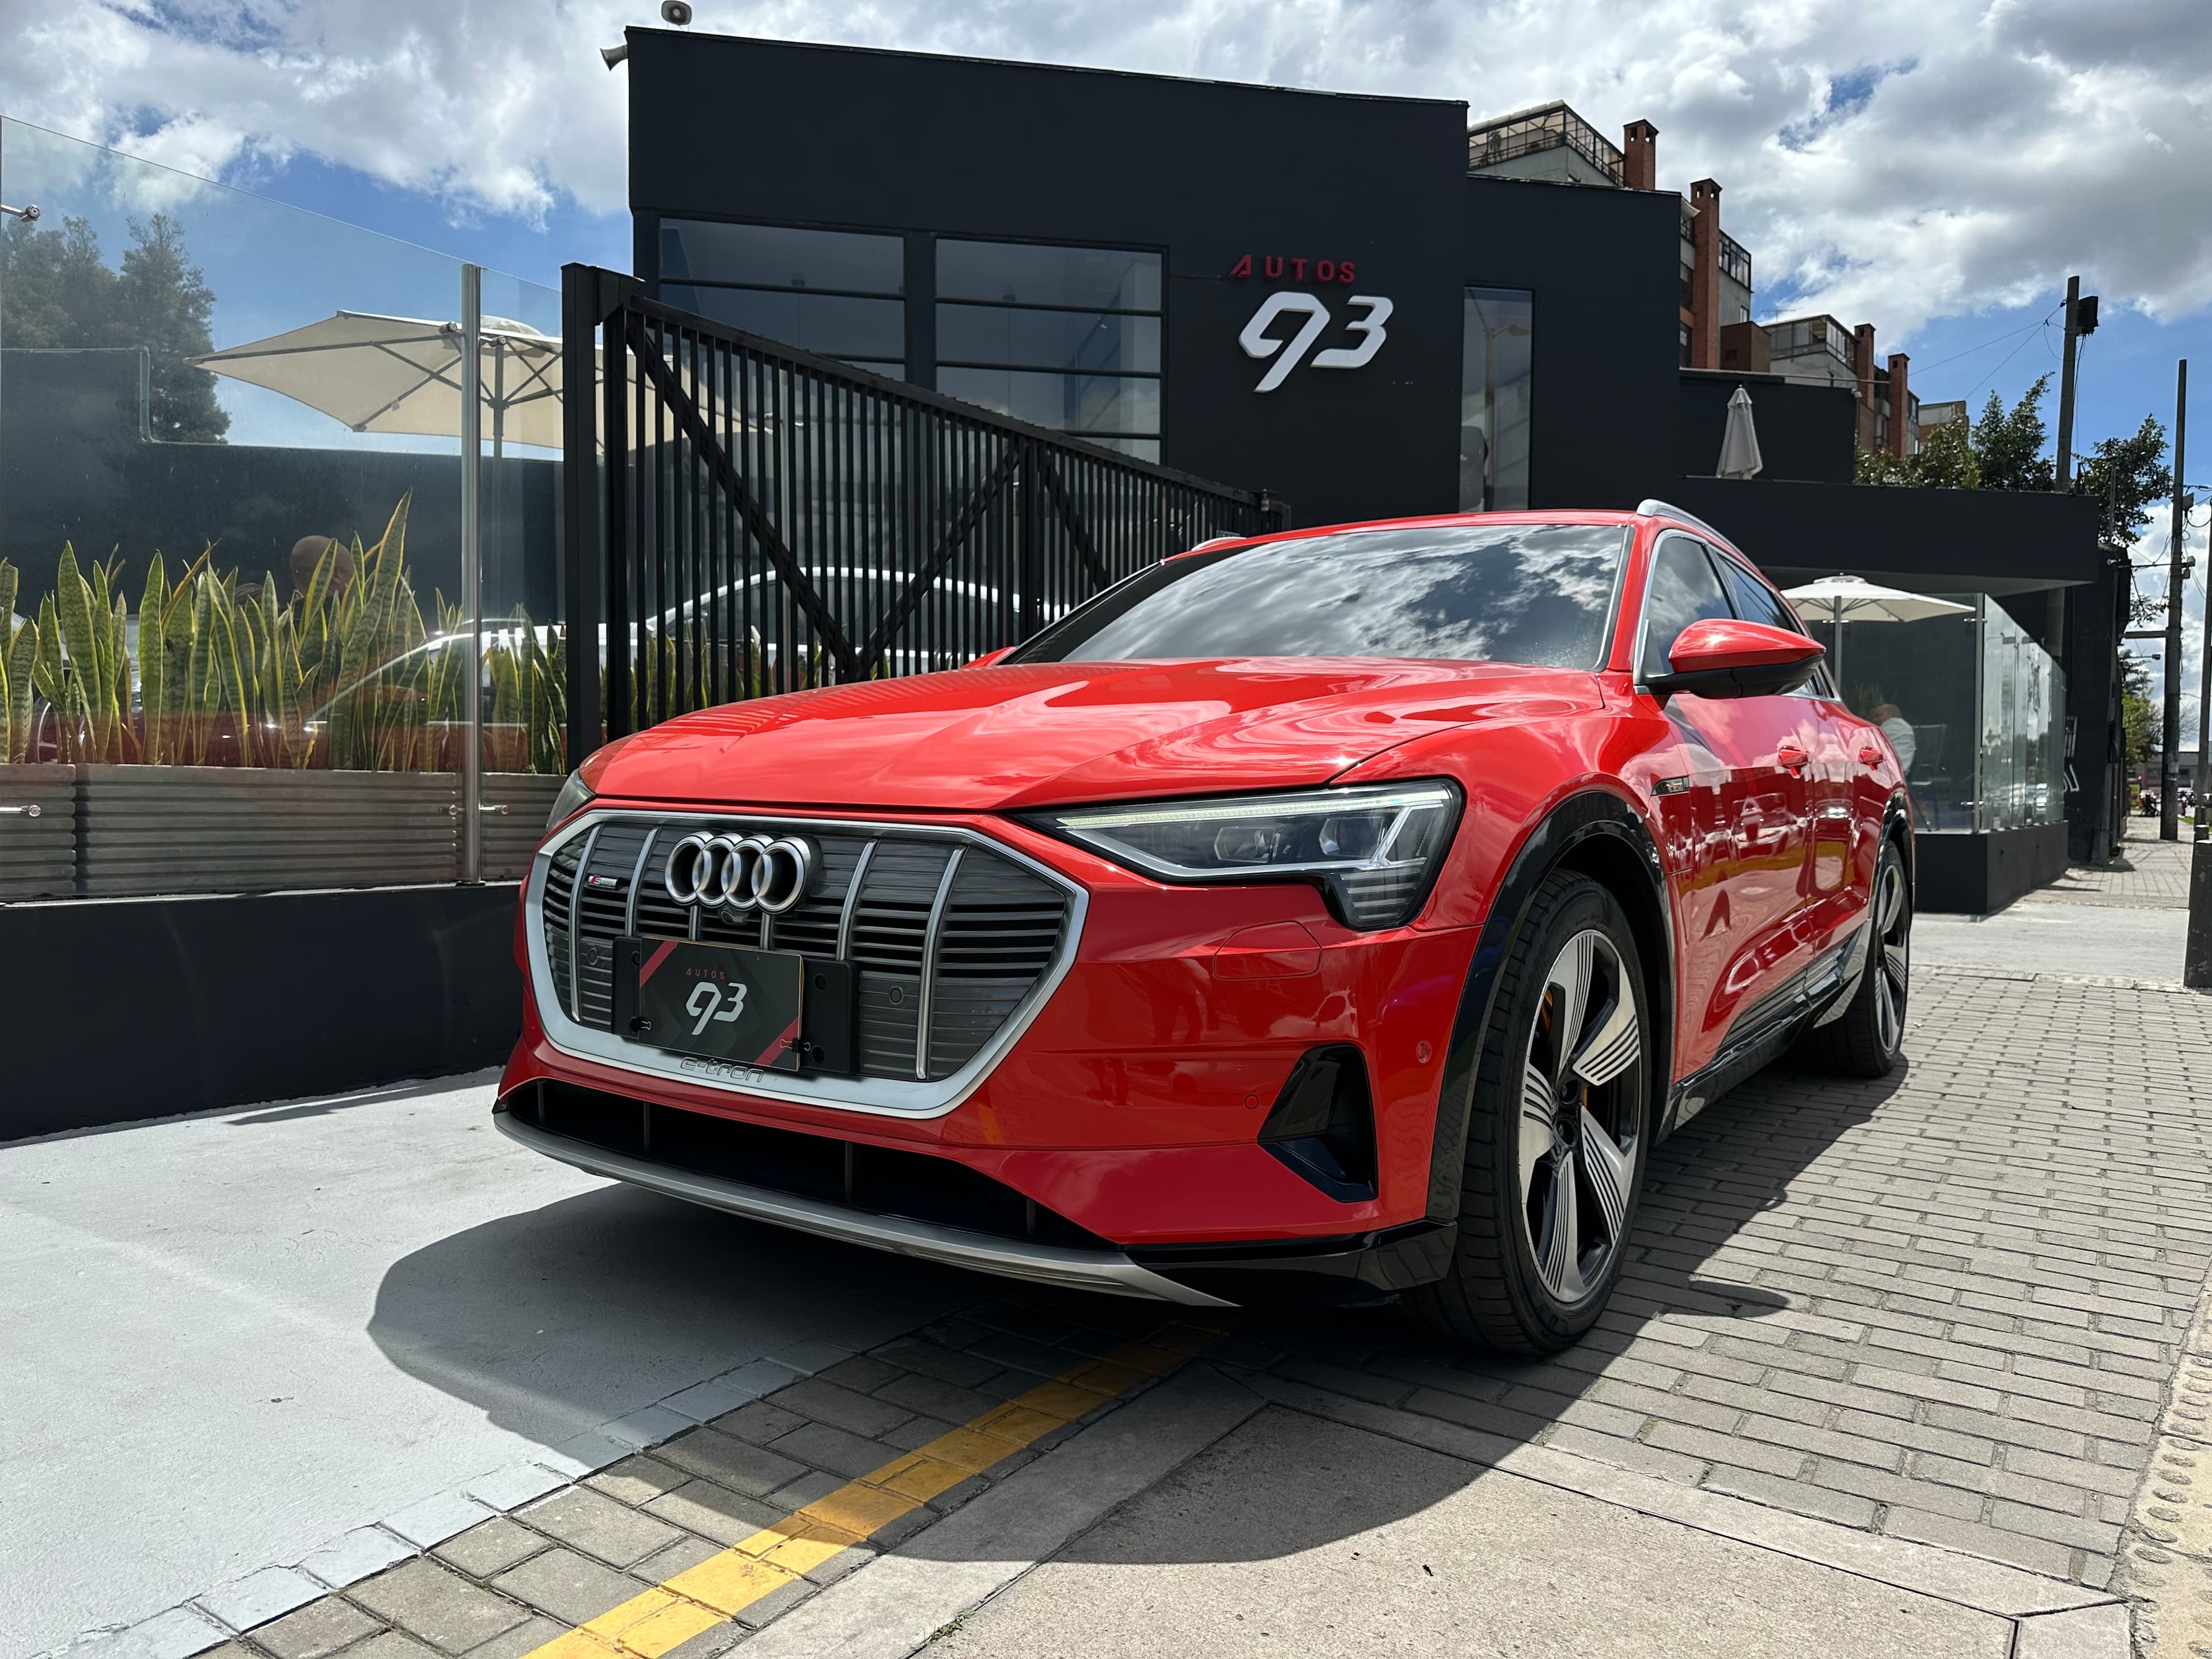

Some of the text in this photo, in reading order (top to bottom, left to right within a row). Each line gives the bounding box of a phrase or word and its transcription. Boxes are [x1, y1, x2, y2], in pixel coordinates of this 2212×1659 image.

[1230, 254, 1355, 285] AUTOS
[1238, 291, 1393, 393] 93
[685, 967, 725, 980] AUTOS
[685, 982, 747, 1035] 93
[680, 1056, 765, 1083] e-tron
